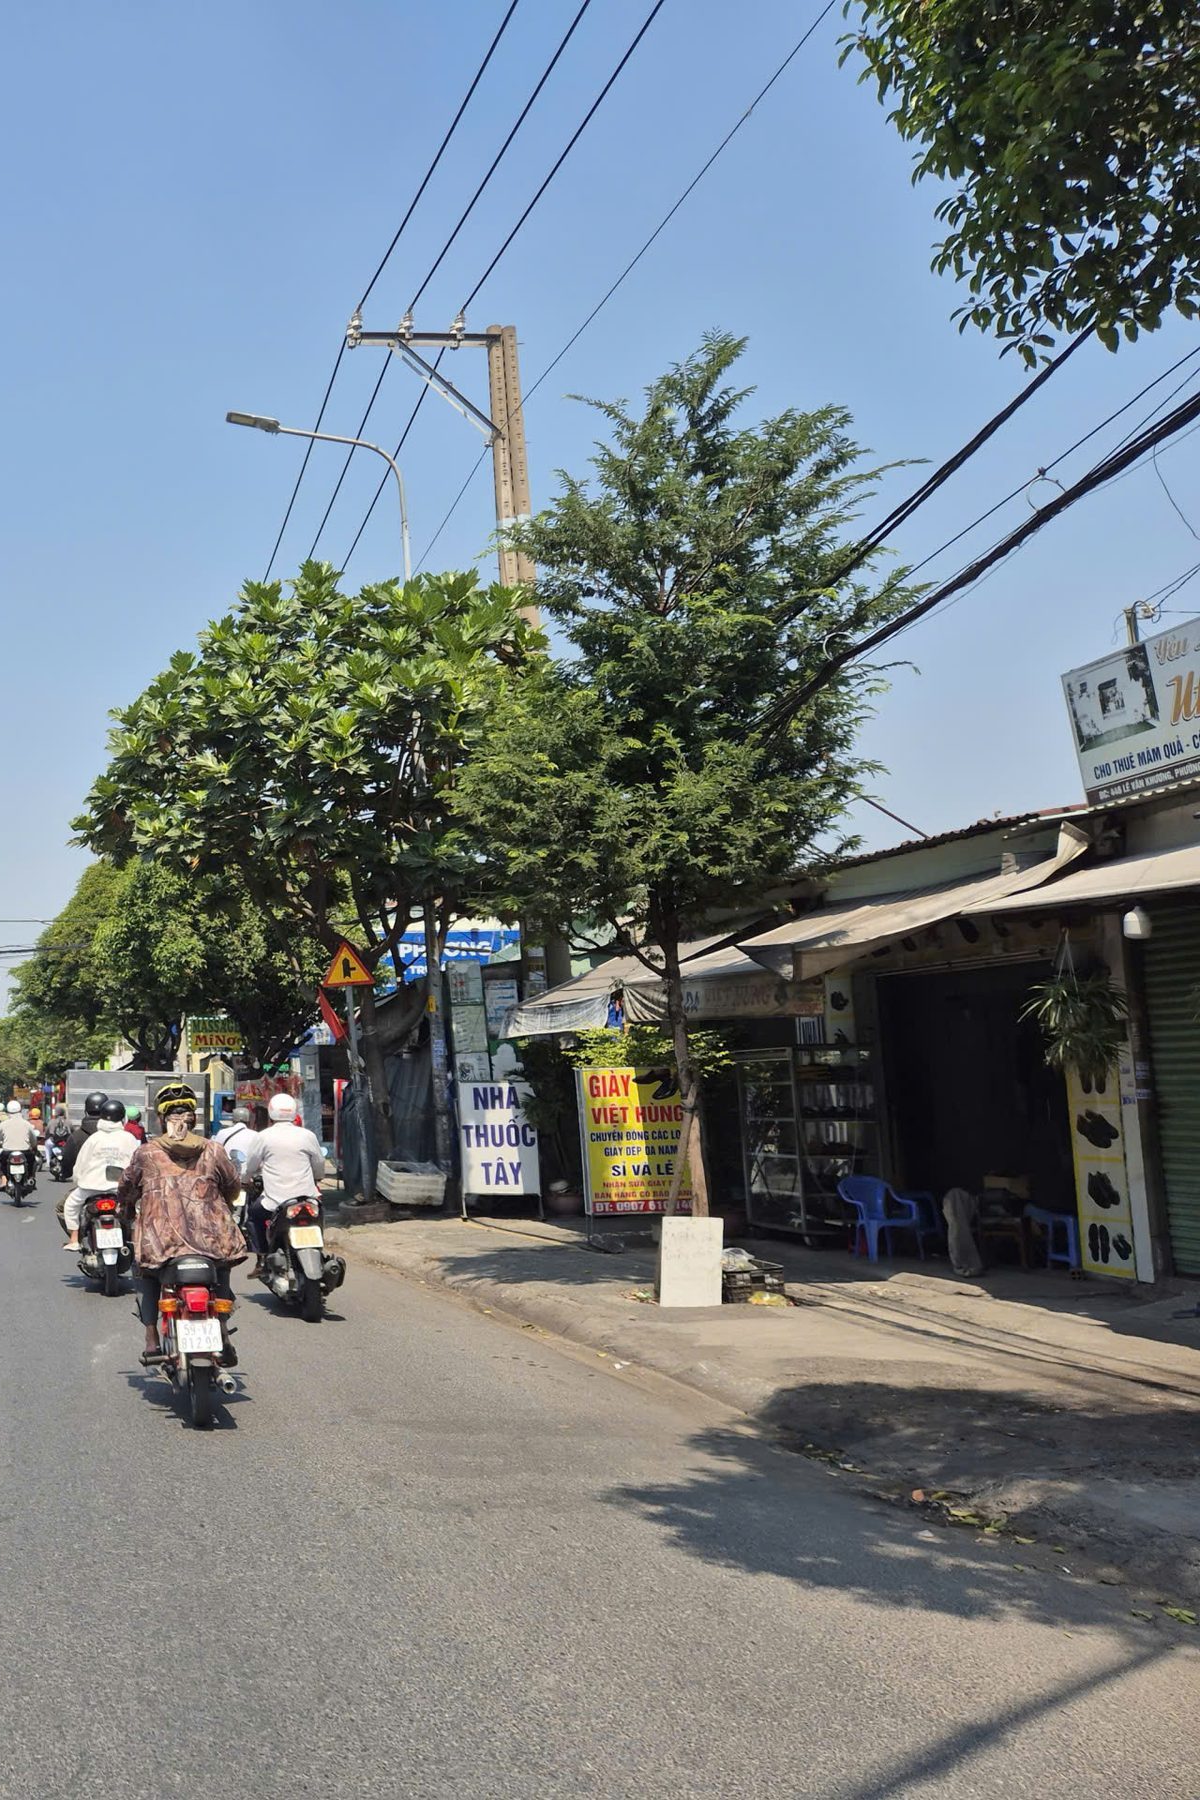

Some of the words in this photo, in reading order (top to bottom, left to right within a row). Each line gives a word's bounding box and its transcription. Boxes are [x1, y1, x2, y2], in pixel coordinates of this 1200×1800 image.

[1094, 763, 1112, 780] CHO
[1113, 752, 1136, 774] THUÊ
[1163, 735, 1184, 759] QUẢ
[473, 1081, 521, 1110] NHÀ
[588, 1070, 631, 1098] GIÀY
[592, 1103, 629, 1128] VIỆT
[636, 1102, 684, 1123] HÙNG
[462, 1115, 536, 1148] THUỐC
[481, 1157, 522, 1185] TÂY
[632, 1161, 651, 1176] VÀ
